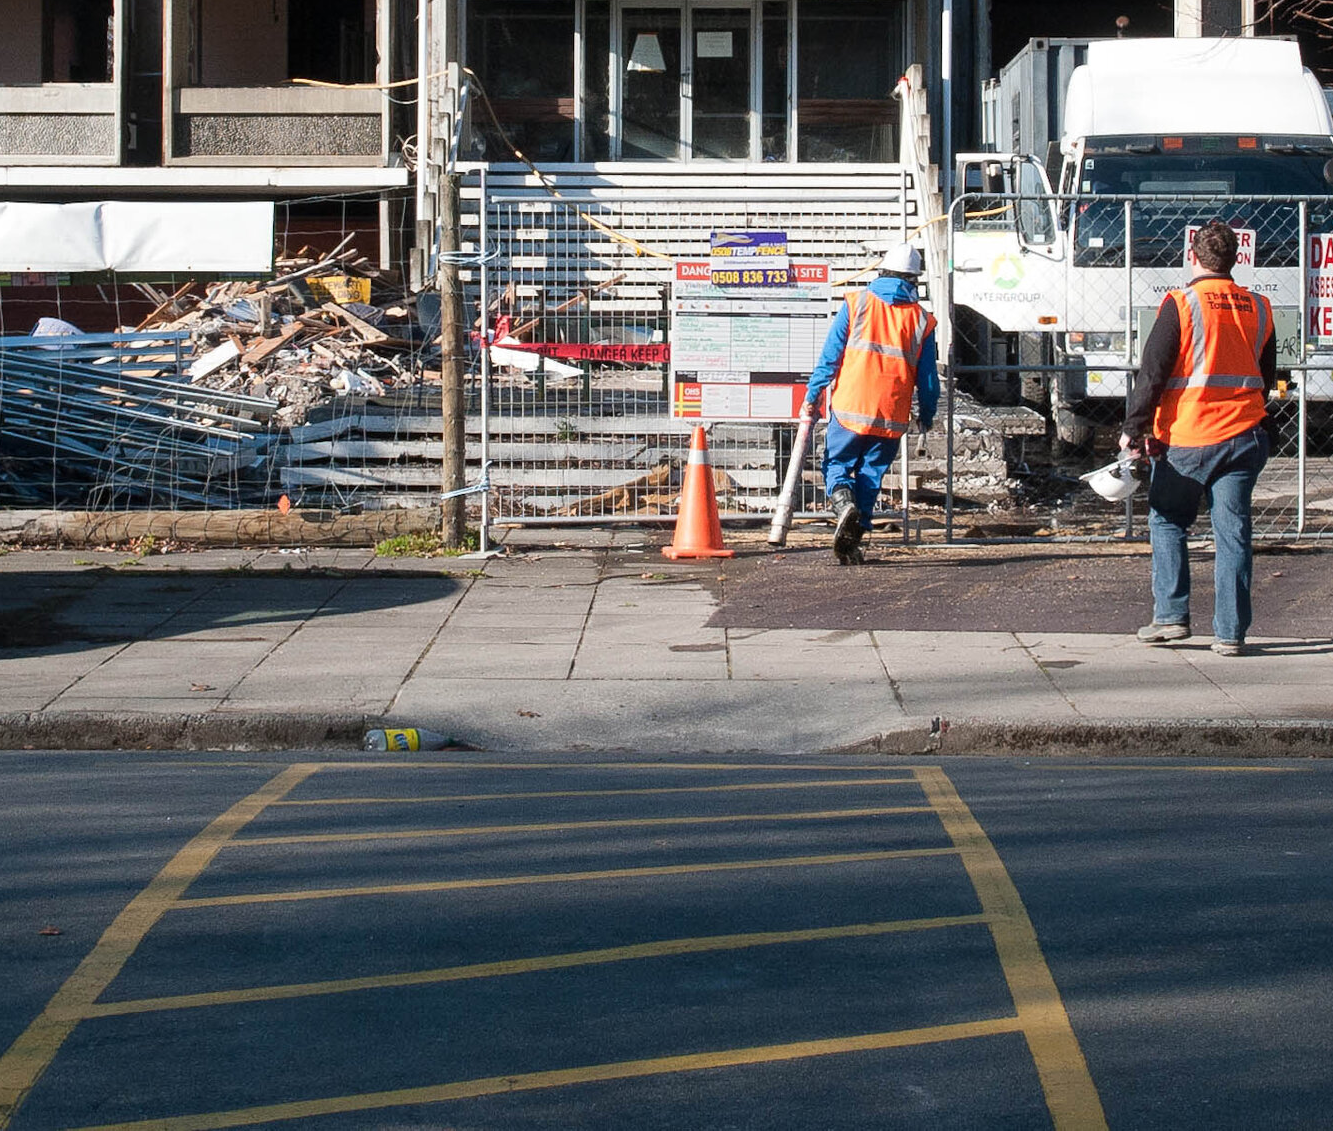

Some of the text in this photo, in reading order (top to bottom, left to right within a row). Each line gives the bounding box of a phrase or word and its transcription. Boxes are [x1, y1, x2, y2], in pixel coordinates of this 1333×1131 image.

[681, 265, 710, 276] DANG
[800, 267, 824, 278] SITE
[712, 271, 740, 284] 0508
[742, 271, 764, 284] 836
[767, 270, 788, 283] 733
[973, 292, 1041, 302] INTERGROUP
[580, 348, 627, 359] DANGER
[631, 349, 659, 361] KEEP
